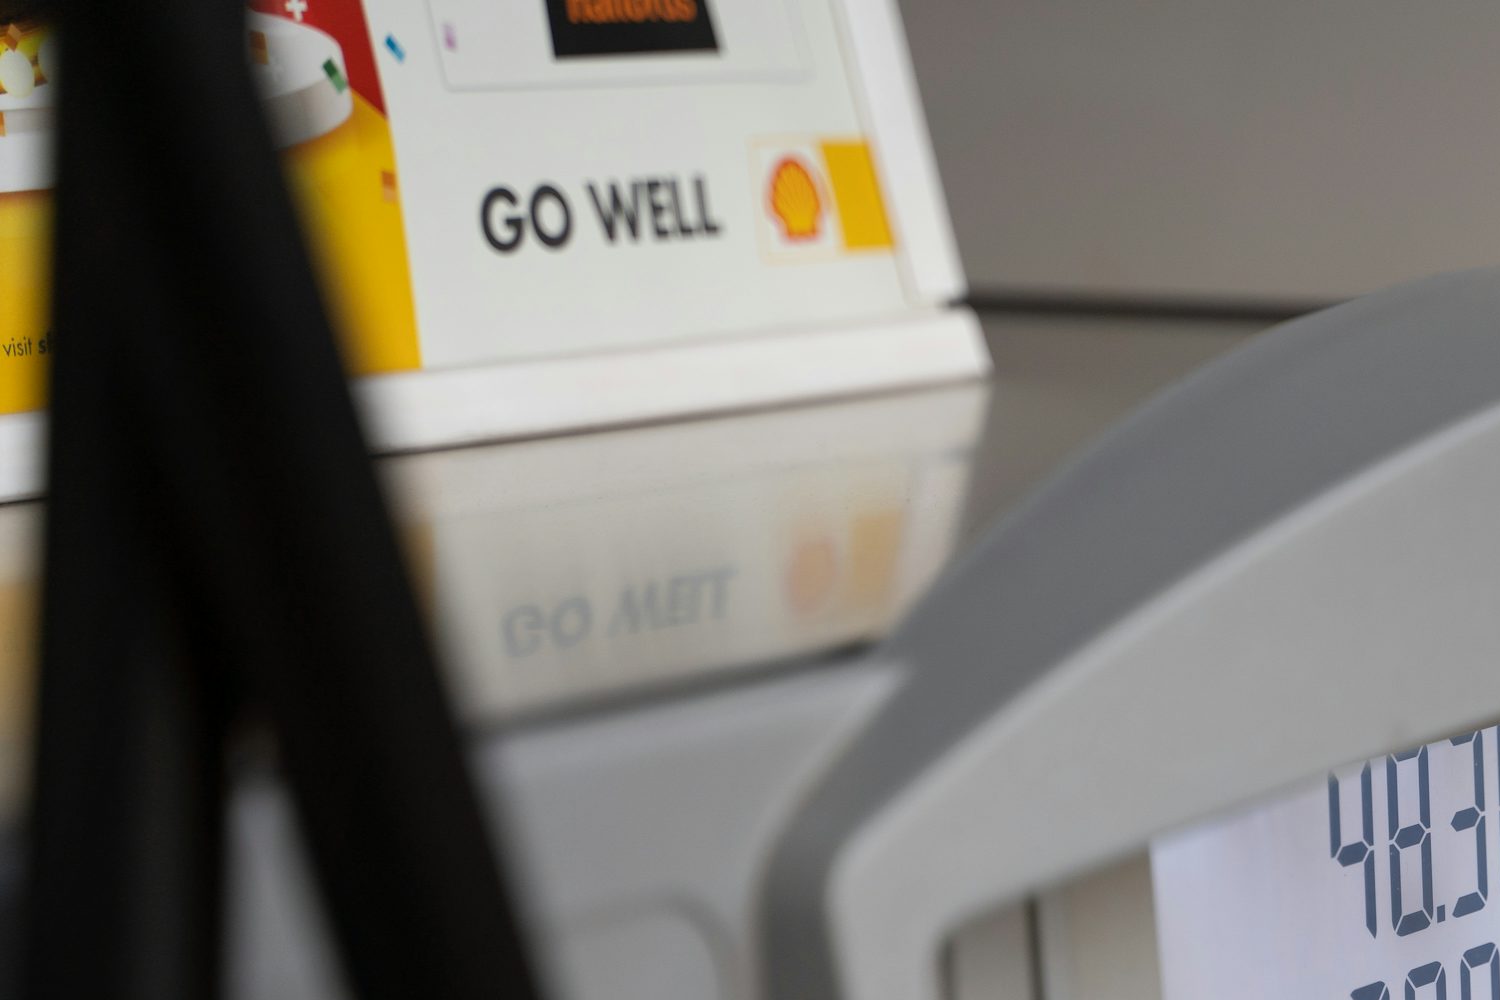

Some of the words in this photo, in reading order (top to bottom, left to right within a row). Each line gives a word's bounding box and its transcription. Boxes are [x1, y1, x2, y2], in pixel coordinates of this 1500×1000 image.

[479, 184, 574, 254] GO
[587, 175, 723, 246] WELL
[2, 336, 32, 357] visit
